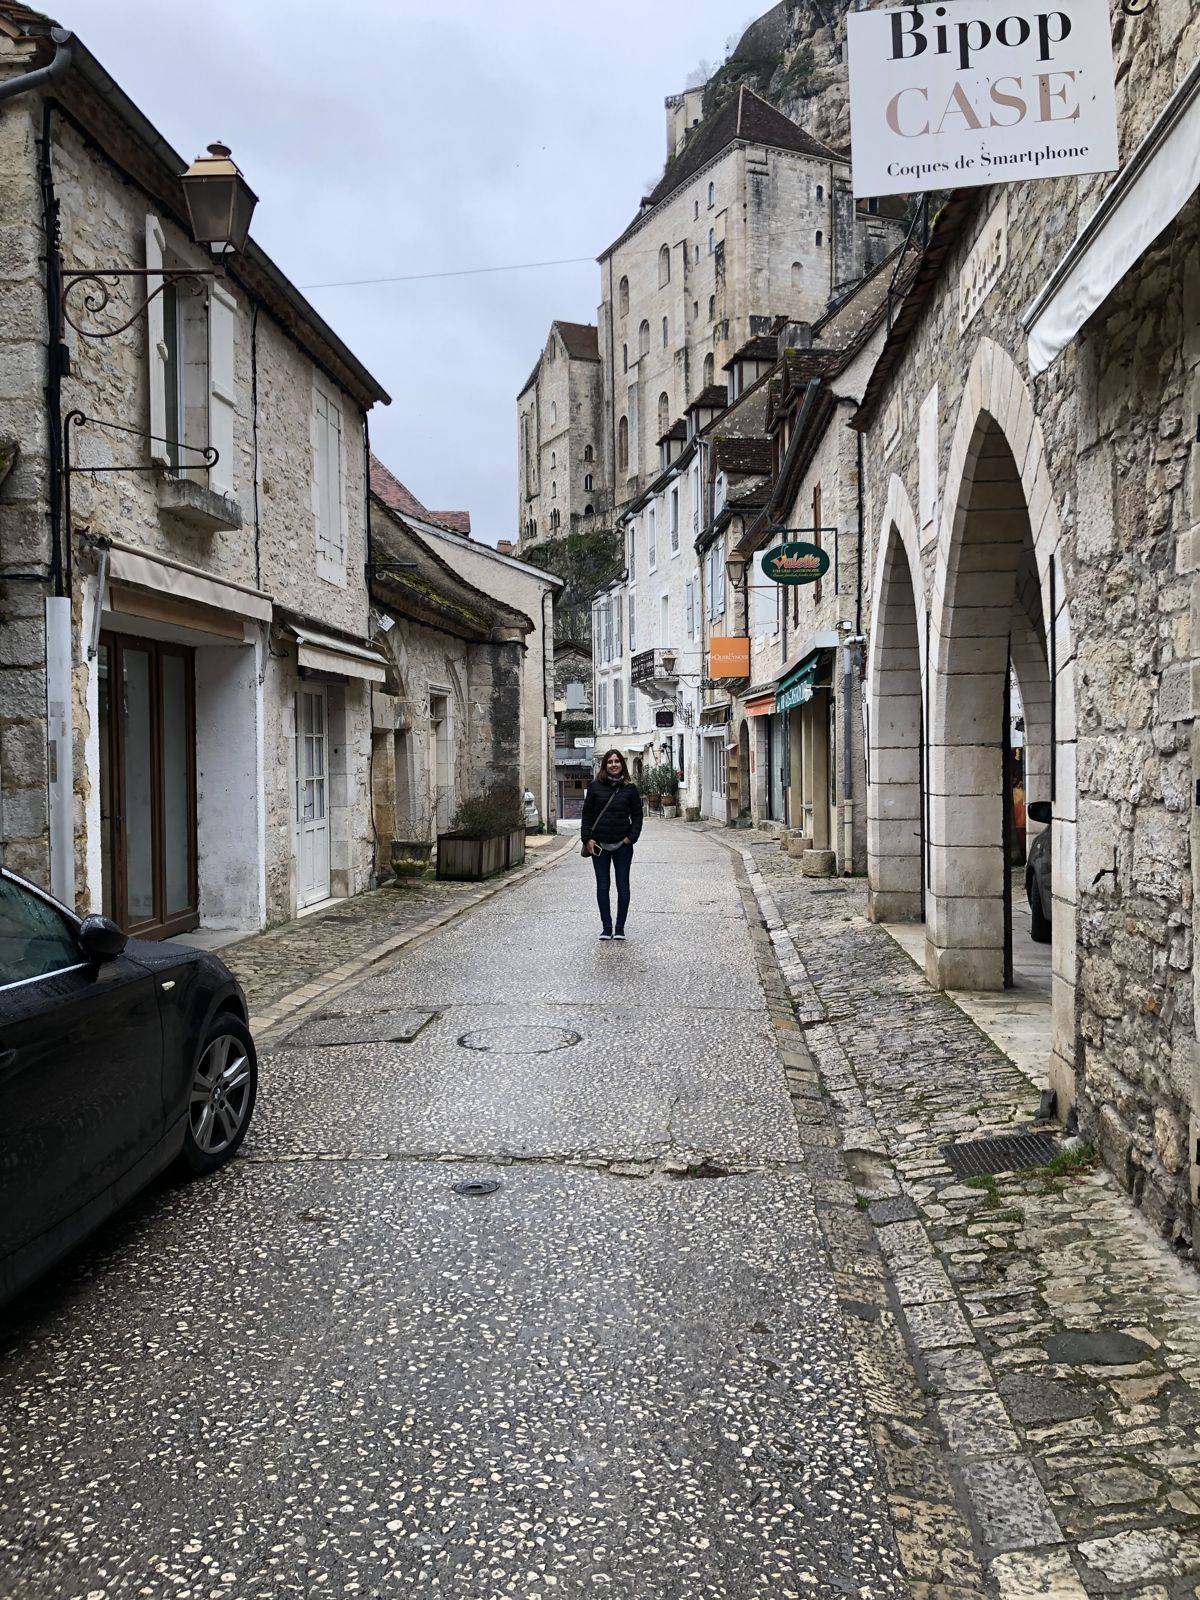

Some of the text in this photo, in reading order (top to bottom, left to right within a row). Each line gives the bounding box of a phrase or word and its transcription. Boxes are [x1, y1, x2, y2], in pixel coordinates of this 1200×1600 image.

[885, 7, 1072, 71] Bipop
[885, 70, 1081, 138] CASE
[887, 145, 1089, 179] Coques de Smartphone
[770, 551, 820, 569] Valette
